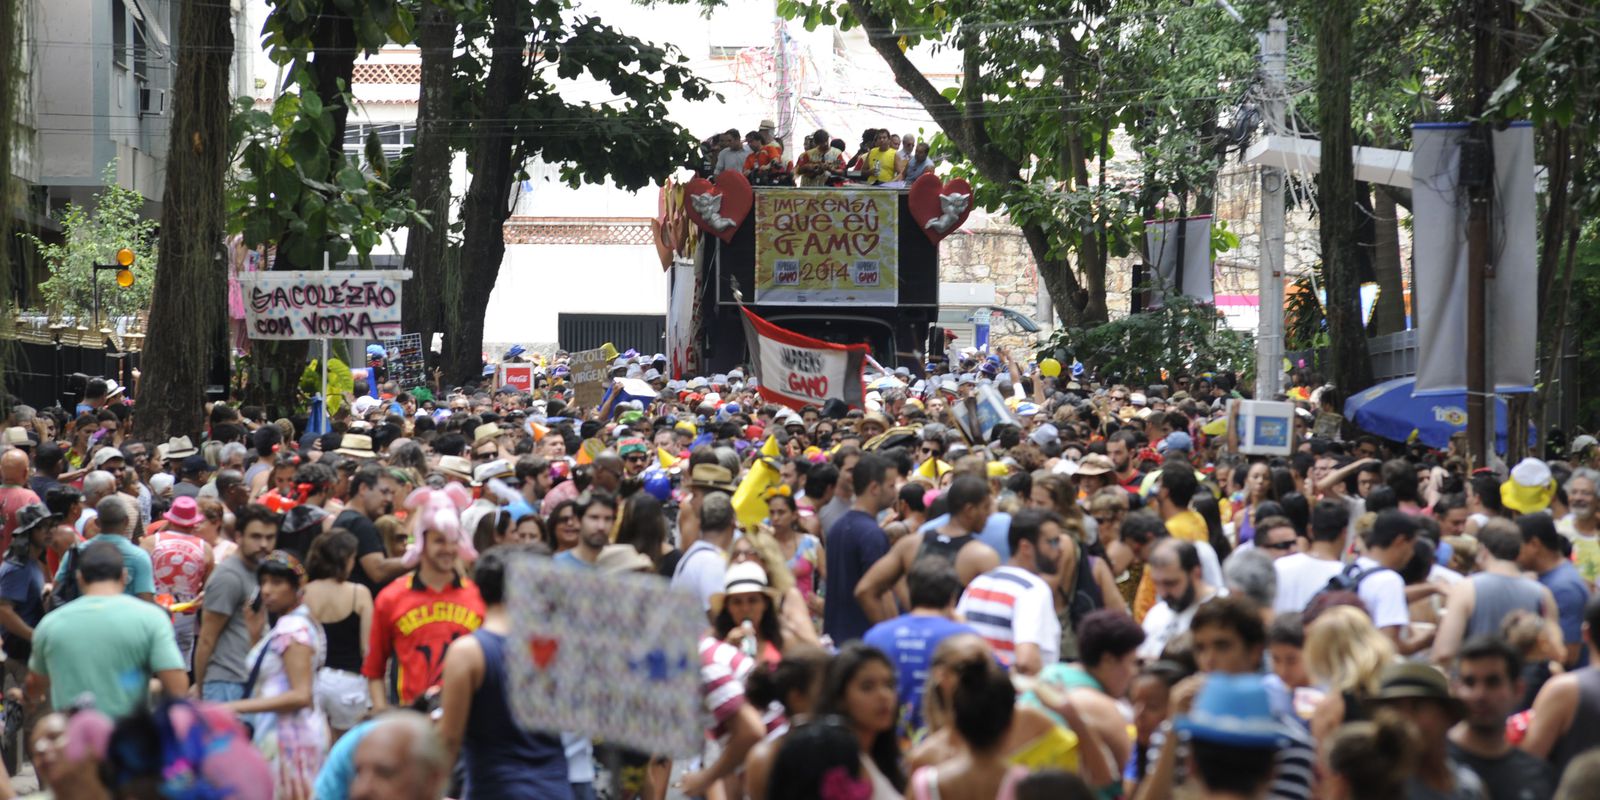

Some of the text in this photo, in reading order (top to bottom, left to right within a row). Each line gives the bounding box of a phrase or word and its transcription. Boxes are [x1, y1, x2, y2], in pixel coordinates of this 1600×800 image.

[800, 262, 850, 281] 2014
[255, 316, 294, 336] COM
[571, 368, 608, 384] VIRGEM
[788, 373, 829, 398] GAMO
[396, 601, 482, 635] BELGIUM
